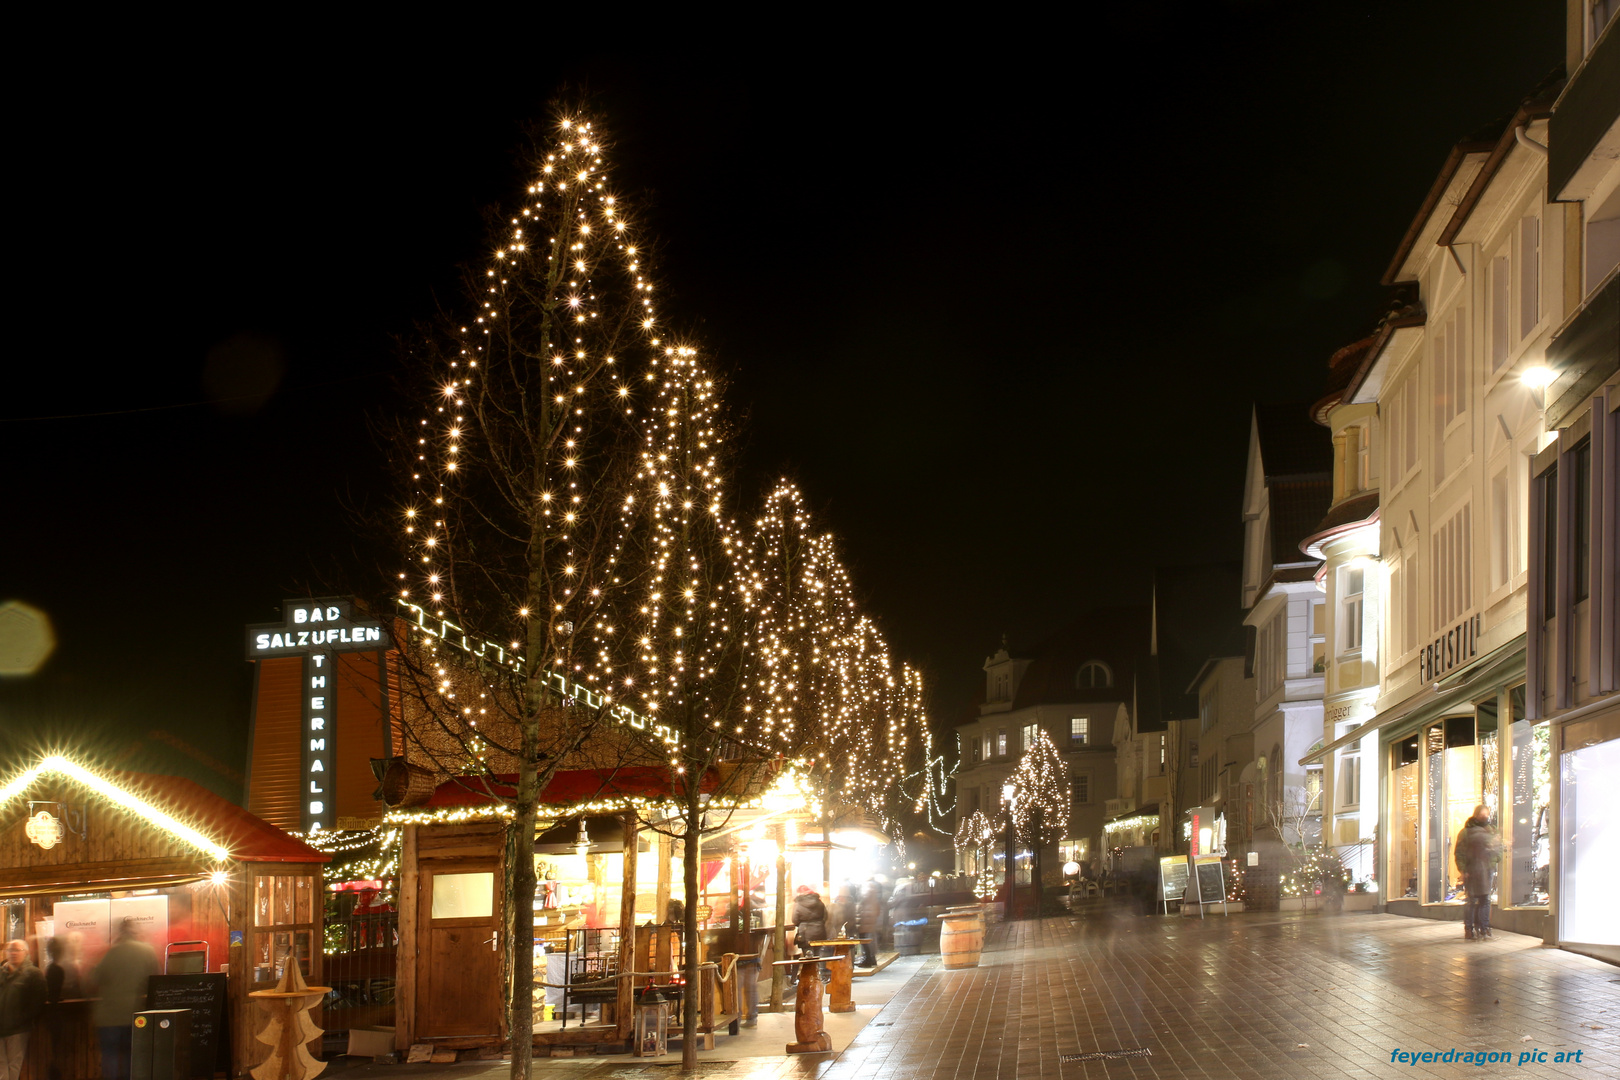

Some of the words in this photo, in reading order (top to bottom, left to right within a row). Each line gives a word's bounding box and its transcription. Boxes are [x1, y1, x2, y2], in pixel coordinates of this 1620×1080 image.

[294, 606, 340, 624] BAD
[256, 627, 380, 650] SALZUFLEN
[1420, 617, 1476, 685] FREISTIL
